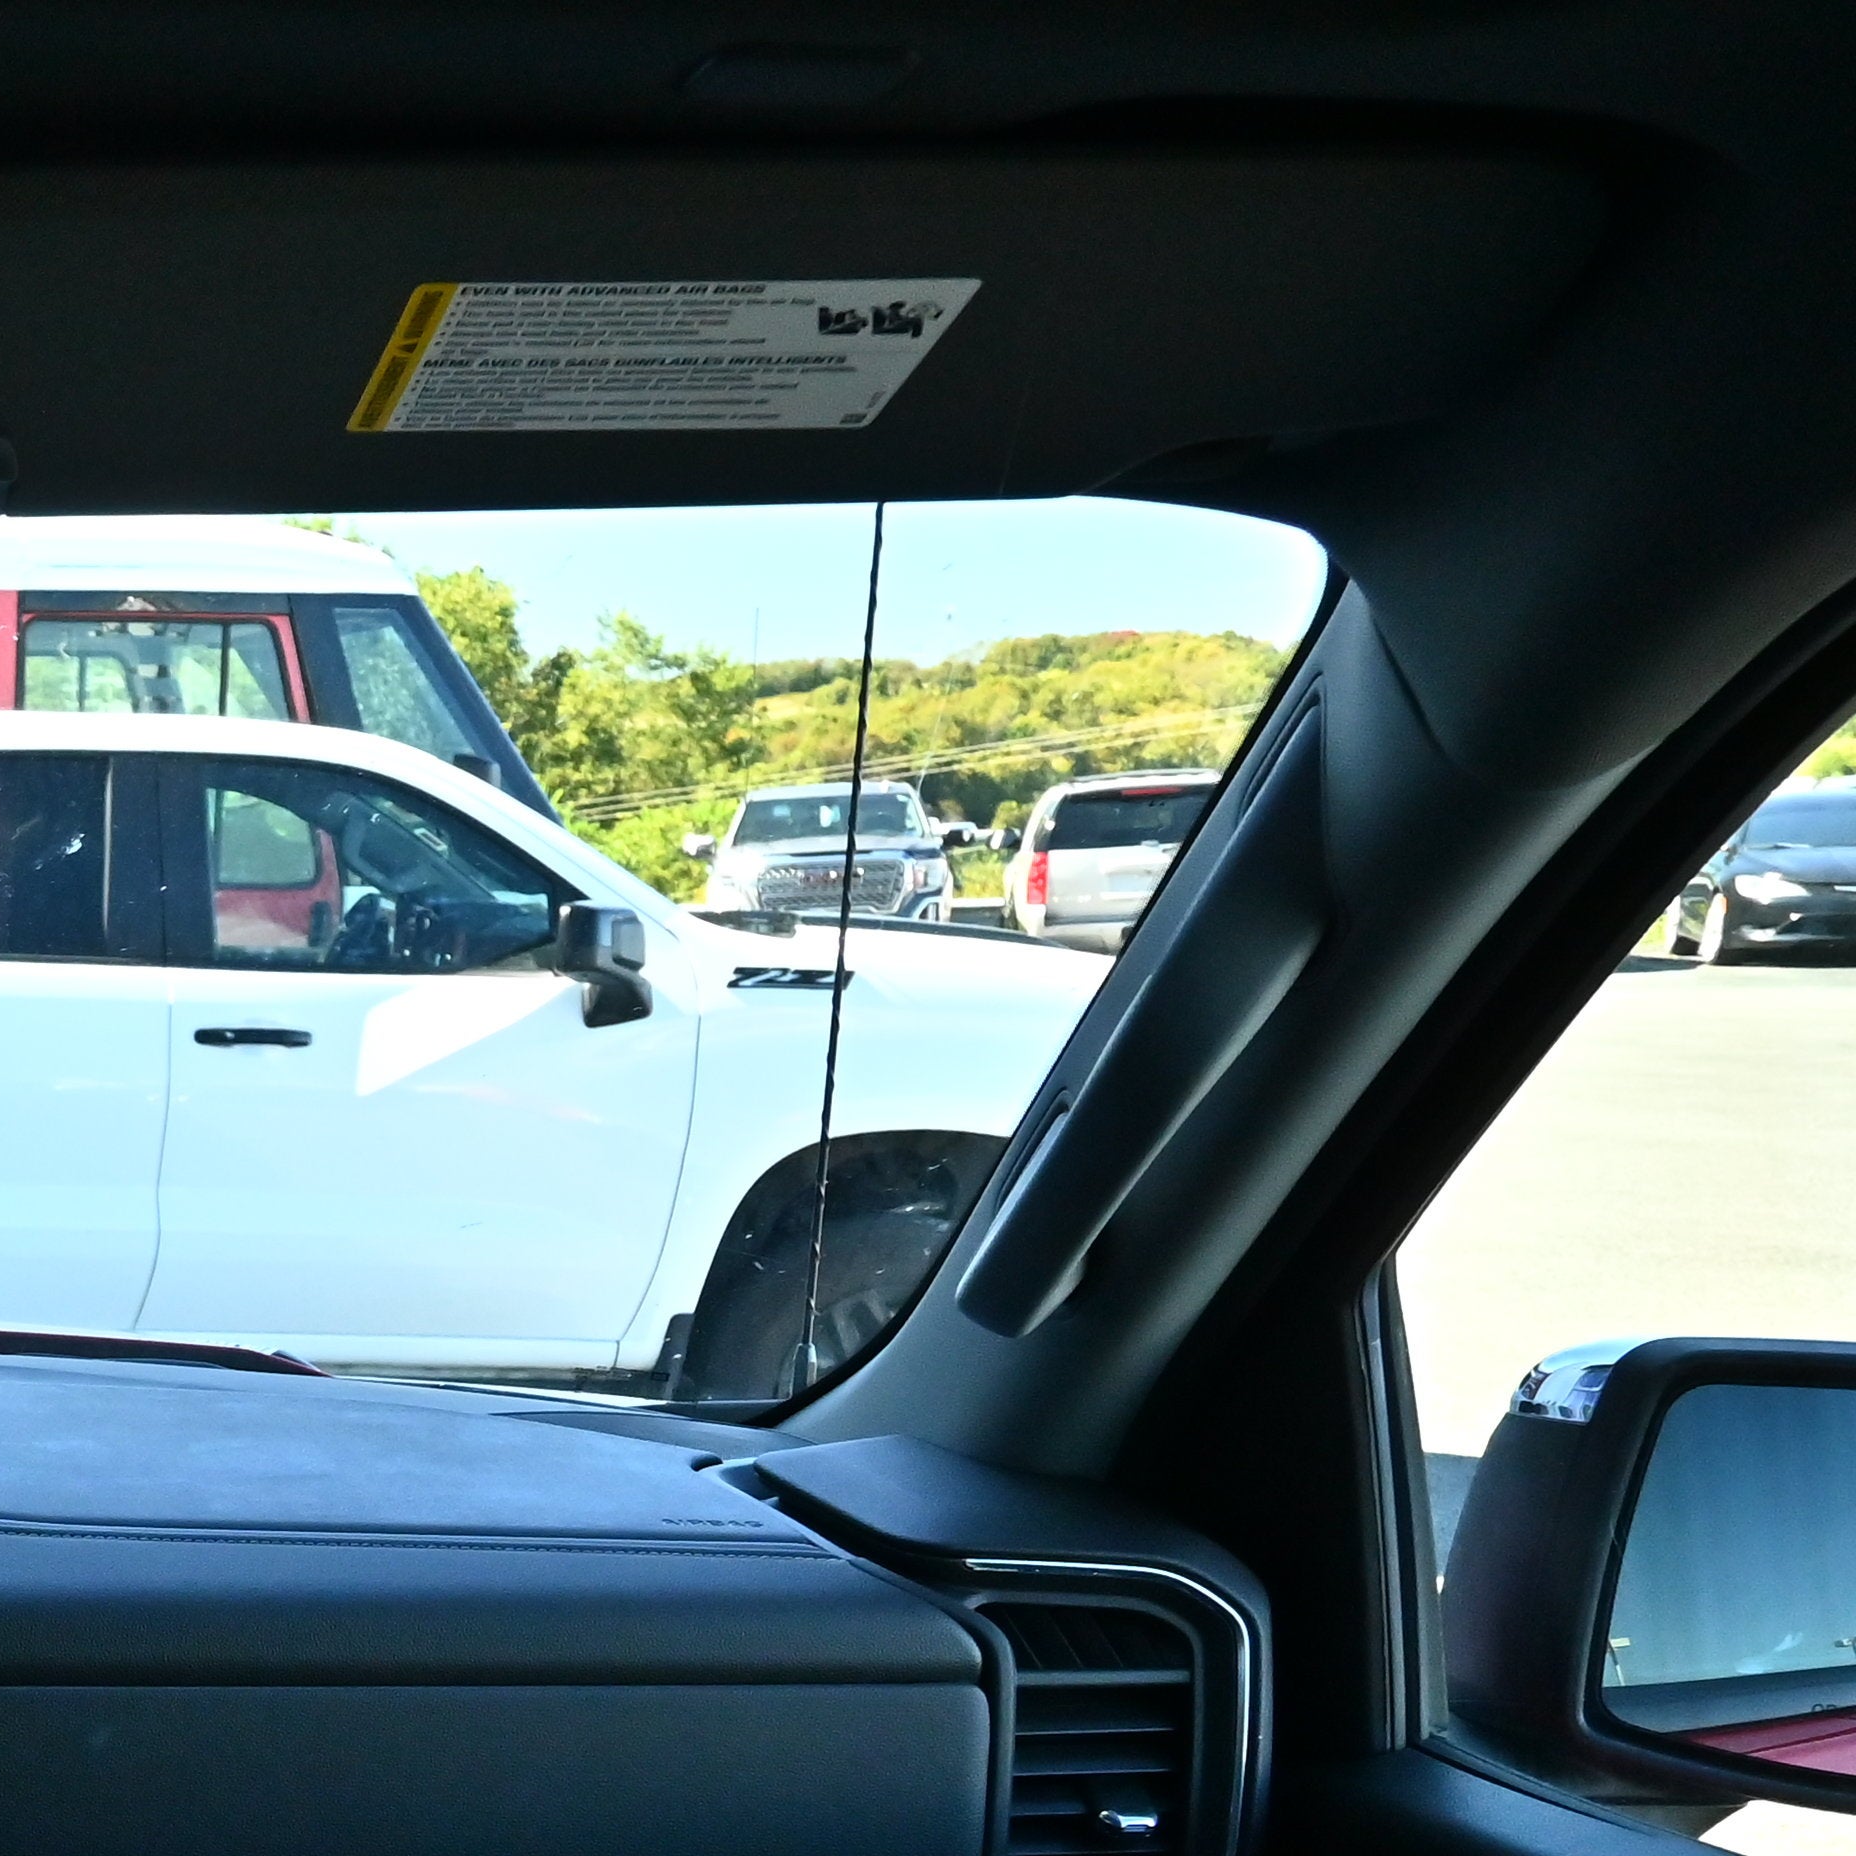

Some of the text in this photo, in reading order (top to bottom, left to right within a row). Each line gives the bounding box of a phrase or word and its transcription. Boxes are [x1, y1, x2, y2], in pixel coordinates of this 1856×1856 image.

[460, 284, 766, 295] EVEN WITH ADVANCED AIR BAGS
